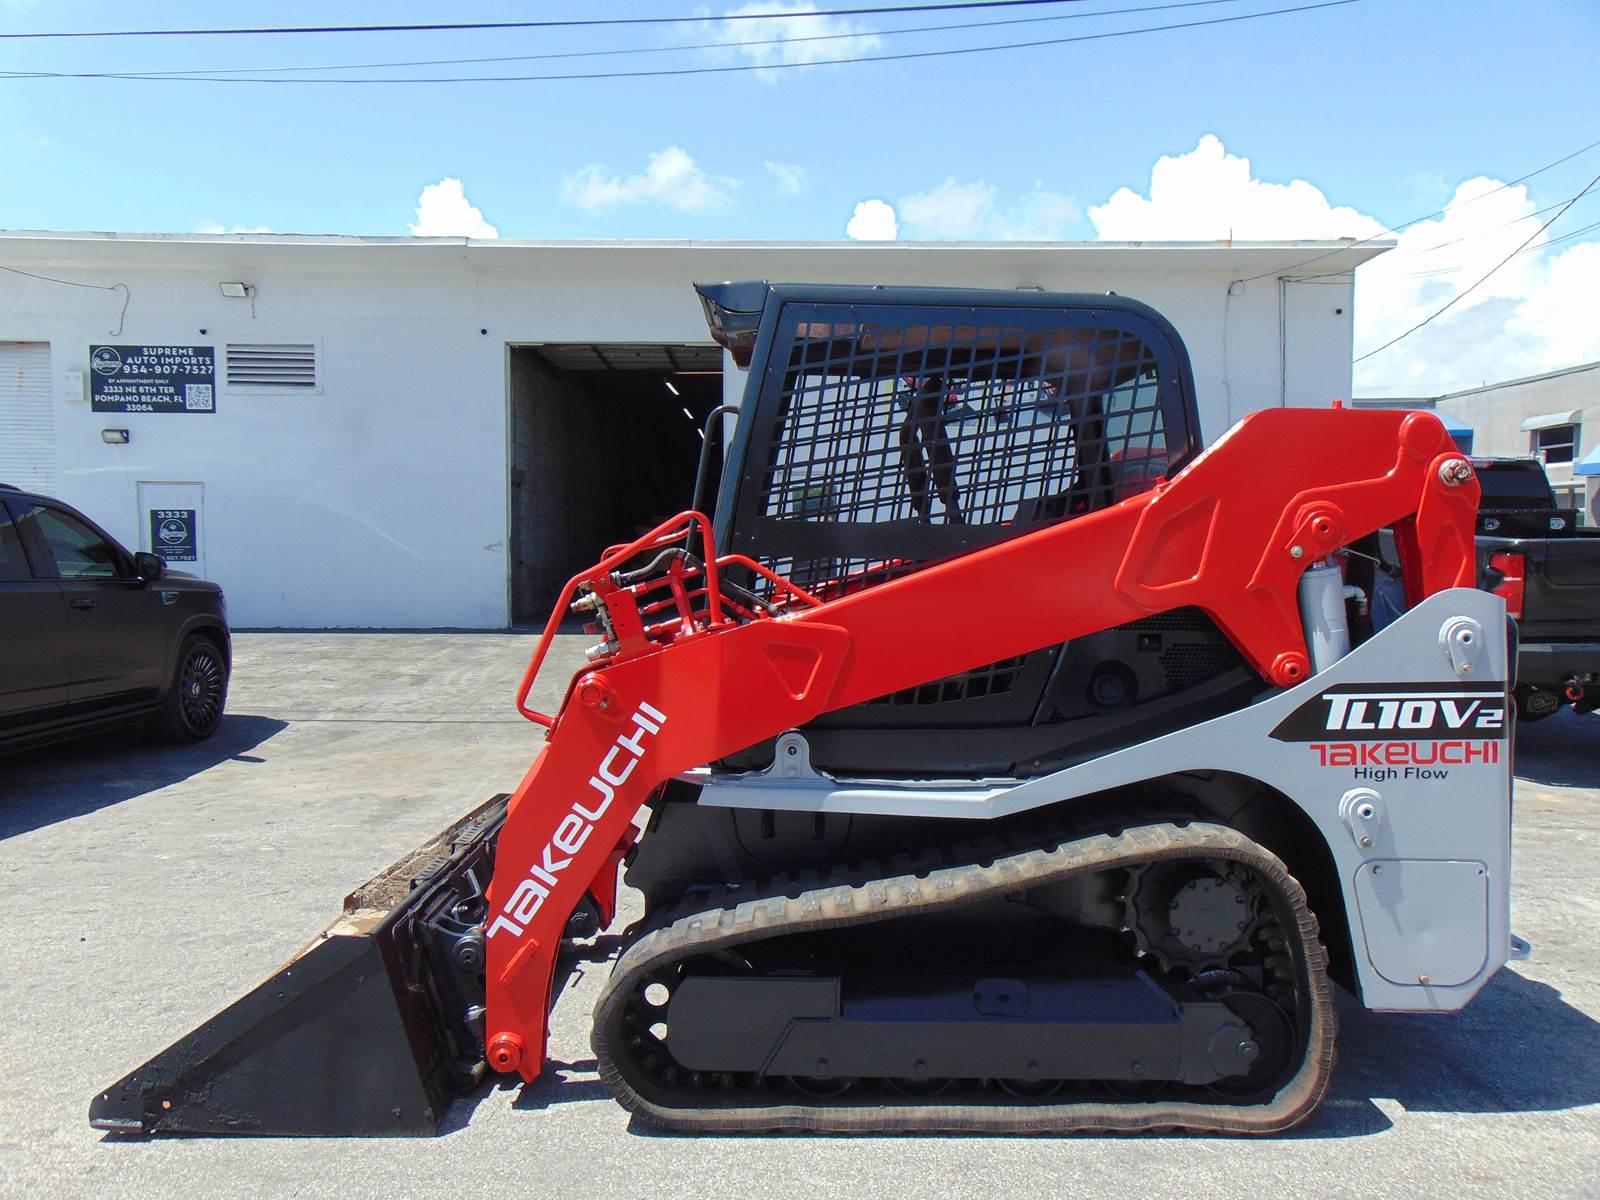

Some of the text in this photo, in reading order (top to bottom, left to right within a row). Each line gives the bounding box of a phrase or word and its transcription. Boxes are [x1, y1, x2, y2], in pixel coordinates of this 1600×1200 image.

[142, 347, 194, 356] SUPREME
[126, 356, 211, 365] AUTO IMPORTS
[123, 365, 214, 374] 954-907-7527
[95, 394, 184, 404] POMPANO BEACH, FL
[1354, 767, 1449, 783] High Flow
